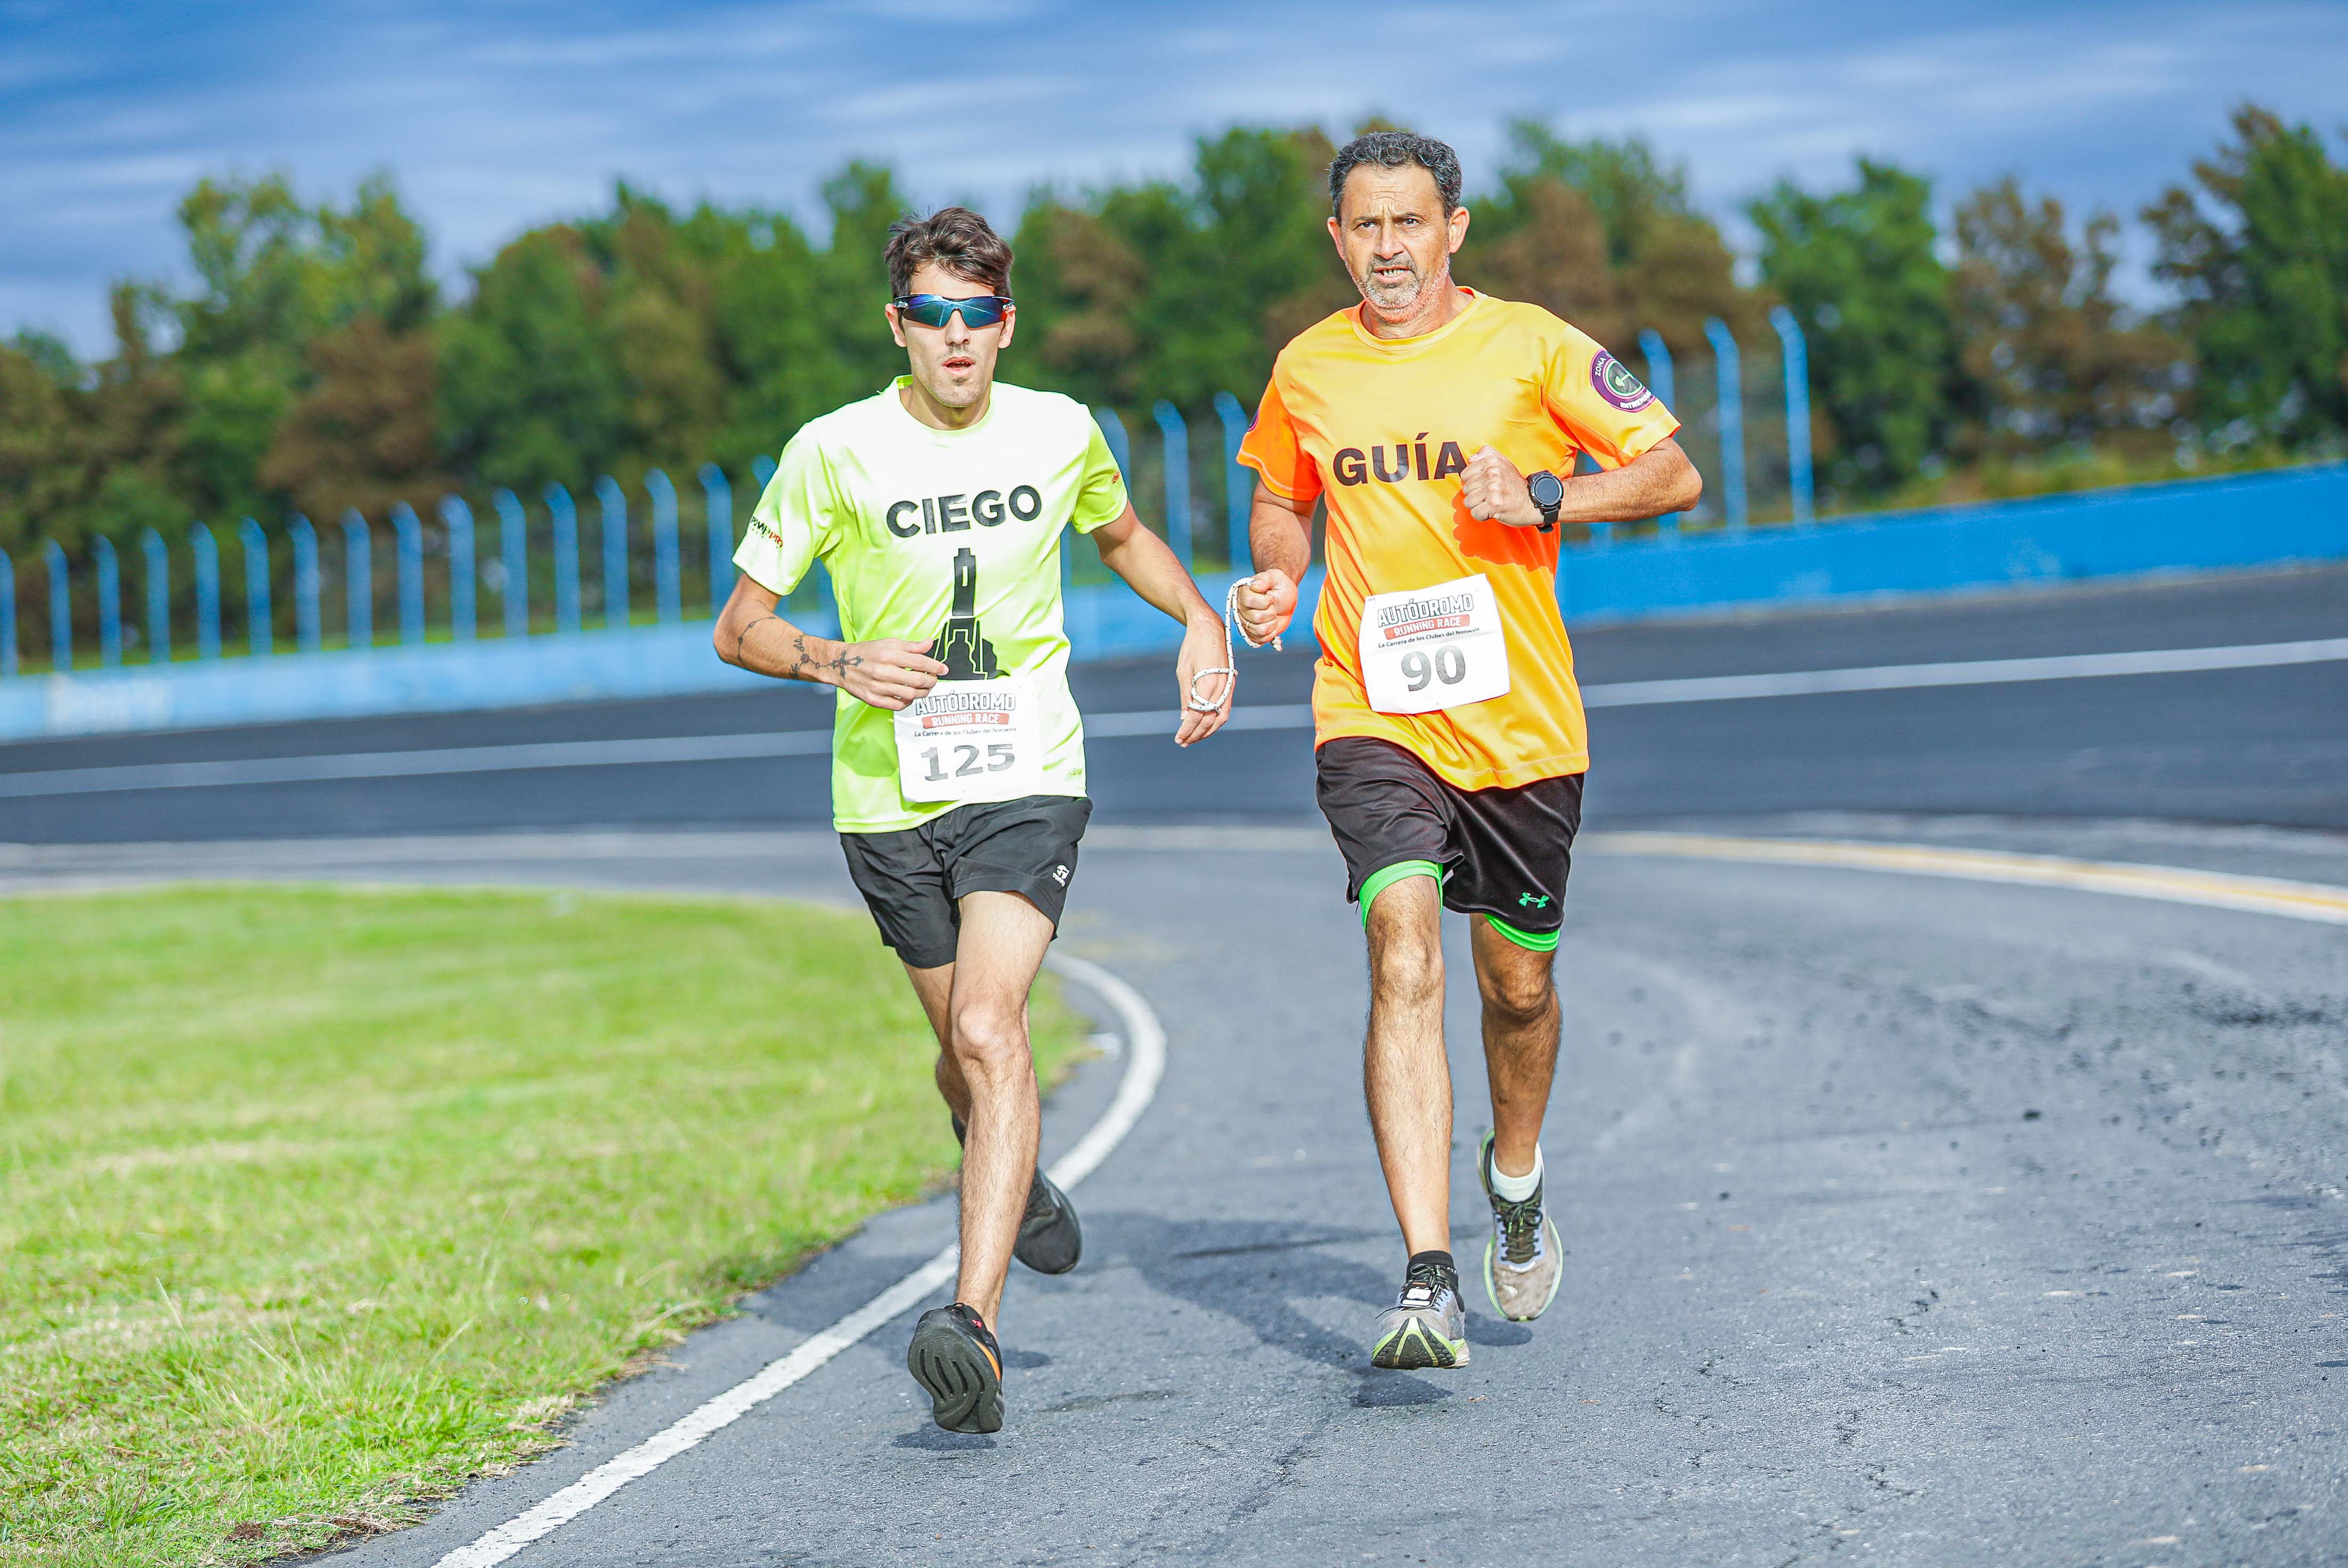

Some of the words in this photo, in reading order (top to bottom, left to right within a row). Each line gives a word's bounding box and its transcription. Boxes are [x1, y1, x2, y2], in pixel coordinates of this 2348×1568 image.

[1595, 358, 1606, 377] ZONA
[1333, 432, 1467, 486] GUÍA
[887, 485, 1042, 538] CIEGO
[1378, 594, 1474, 628] AUTÓDROMO
[1393, 619, 1435, 637] RUNNING
[1437, 616, 1461, 628] RACE
[1401, 645, 1466, 692] 90
[915, 689, 1016, 716] AUTÓDROMO
[932, 714, 973, 727] RUNNING
[976, 713, 1000, 724] RACE
[921, 744, 1015, 782] 125
